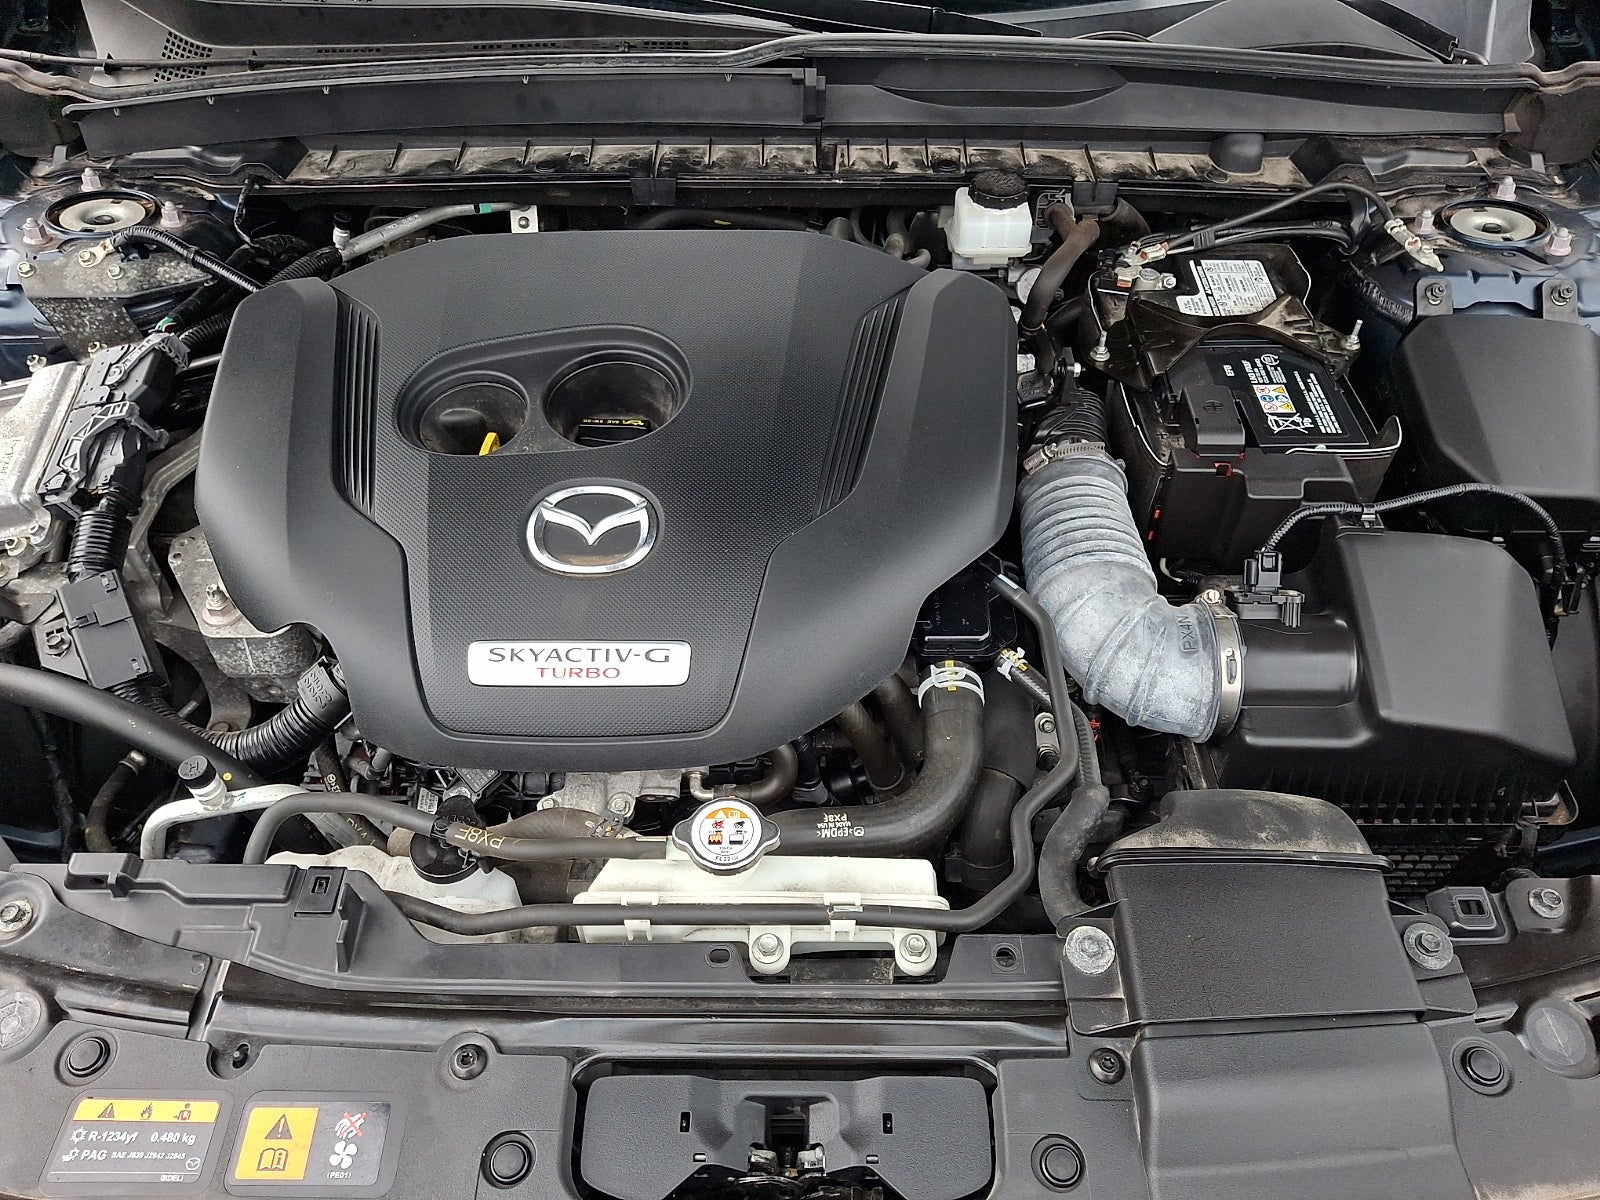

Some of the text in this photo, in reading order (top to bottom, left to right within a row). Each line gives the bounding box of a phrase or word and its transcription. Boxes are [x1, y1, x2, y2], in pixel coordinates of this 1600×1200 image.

[1176, 615, 1197, 651] PX4N
[488, 647, 671, 663] SKYACTIV-G
[536, 667, 621, 679] TURBO
[454, 826, 506, 850] PX8F
[88, 1130, 139, 1145] R-1234yf
[182, 1132, 197, 1146] kg
[80, 1149, 107, 1161] PAG
[111, 1151, 127, 1159] SAE
[326, 1171, 352, 1179] (PE01)
